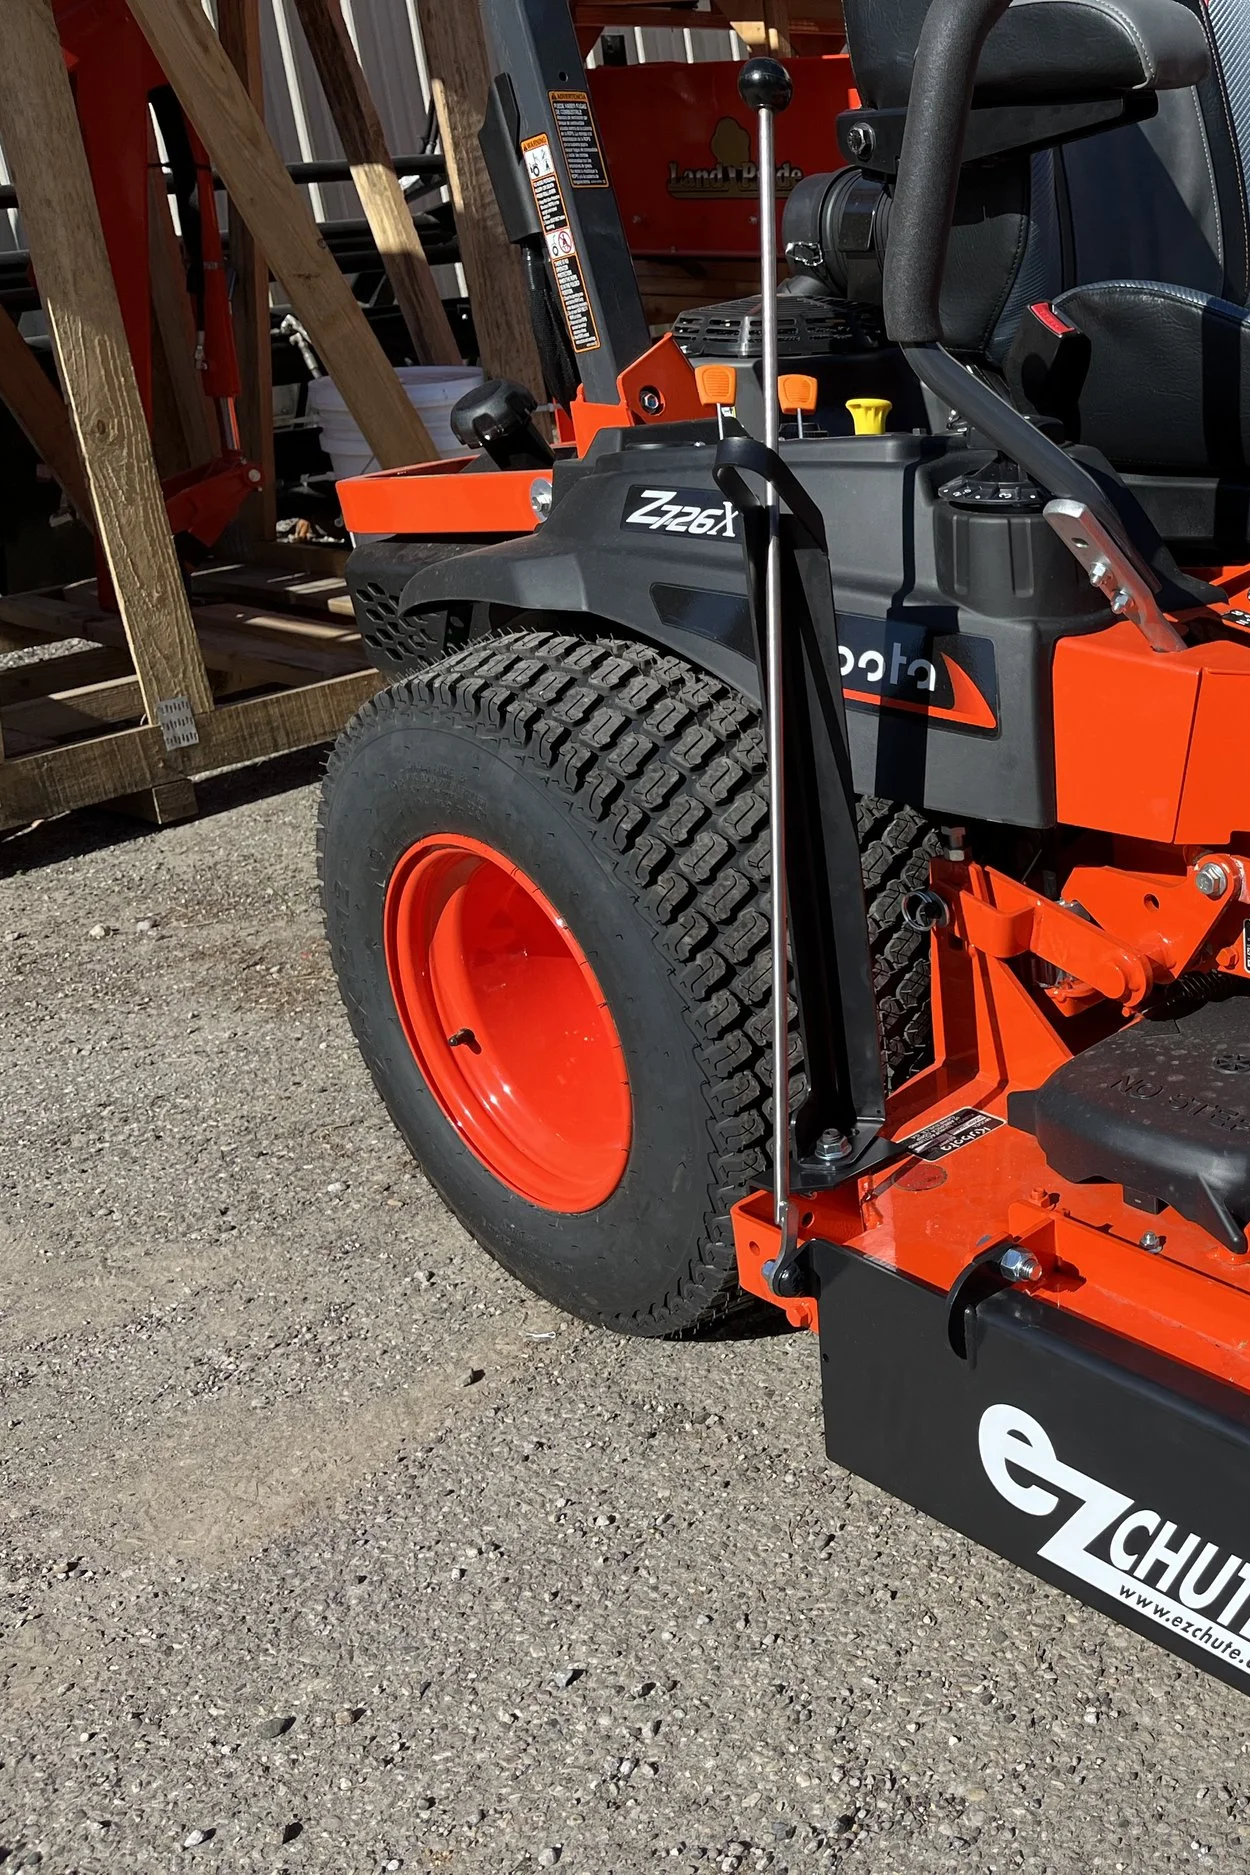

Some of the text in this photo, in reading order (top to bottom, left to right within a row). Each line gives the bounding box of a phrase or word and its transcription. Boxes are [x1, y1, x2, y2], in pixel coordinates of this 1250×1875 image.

[669, 162, 802, 188] Land Pde
[1110, 1075, 1164, 1099] NO
[940, 1127, 991, 1151] Kubota
